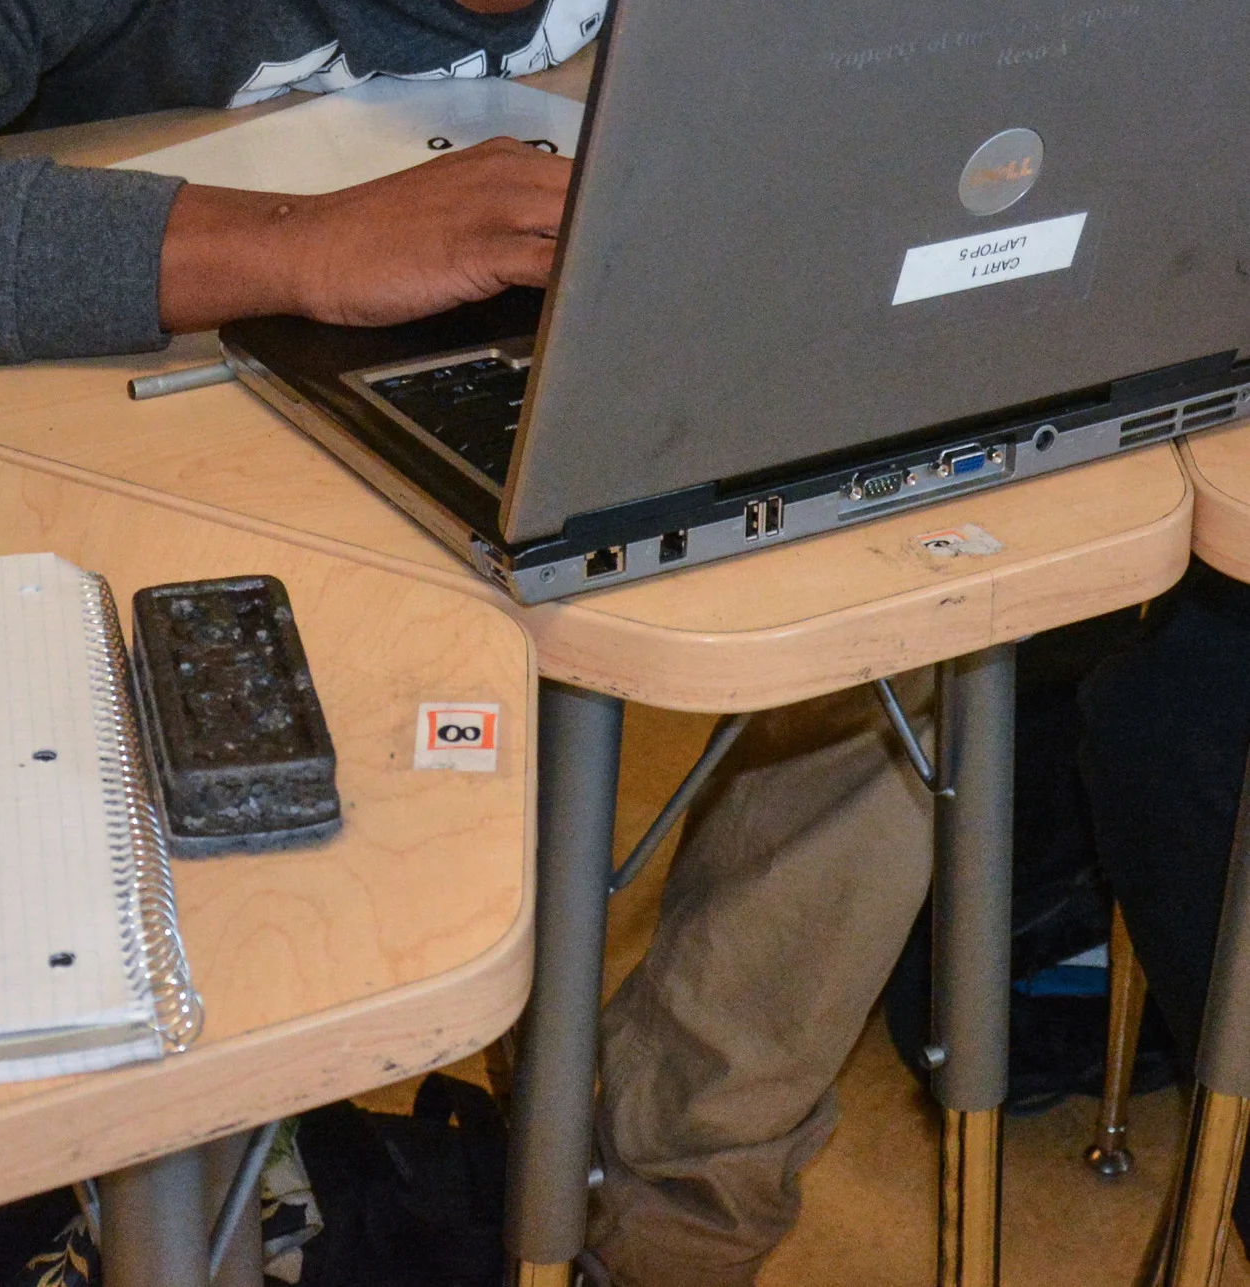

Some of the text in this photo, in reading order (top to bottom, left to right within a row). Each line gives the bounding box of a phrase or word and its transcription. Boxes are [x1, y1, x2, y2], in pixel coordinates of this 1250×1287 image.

[959, 236, 1027, 261] LAPTOP 5
[971, 257, 1020, 278] CART 1
[437, 723, 482, 743] 8
